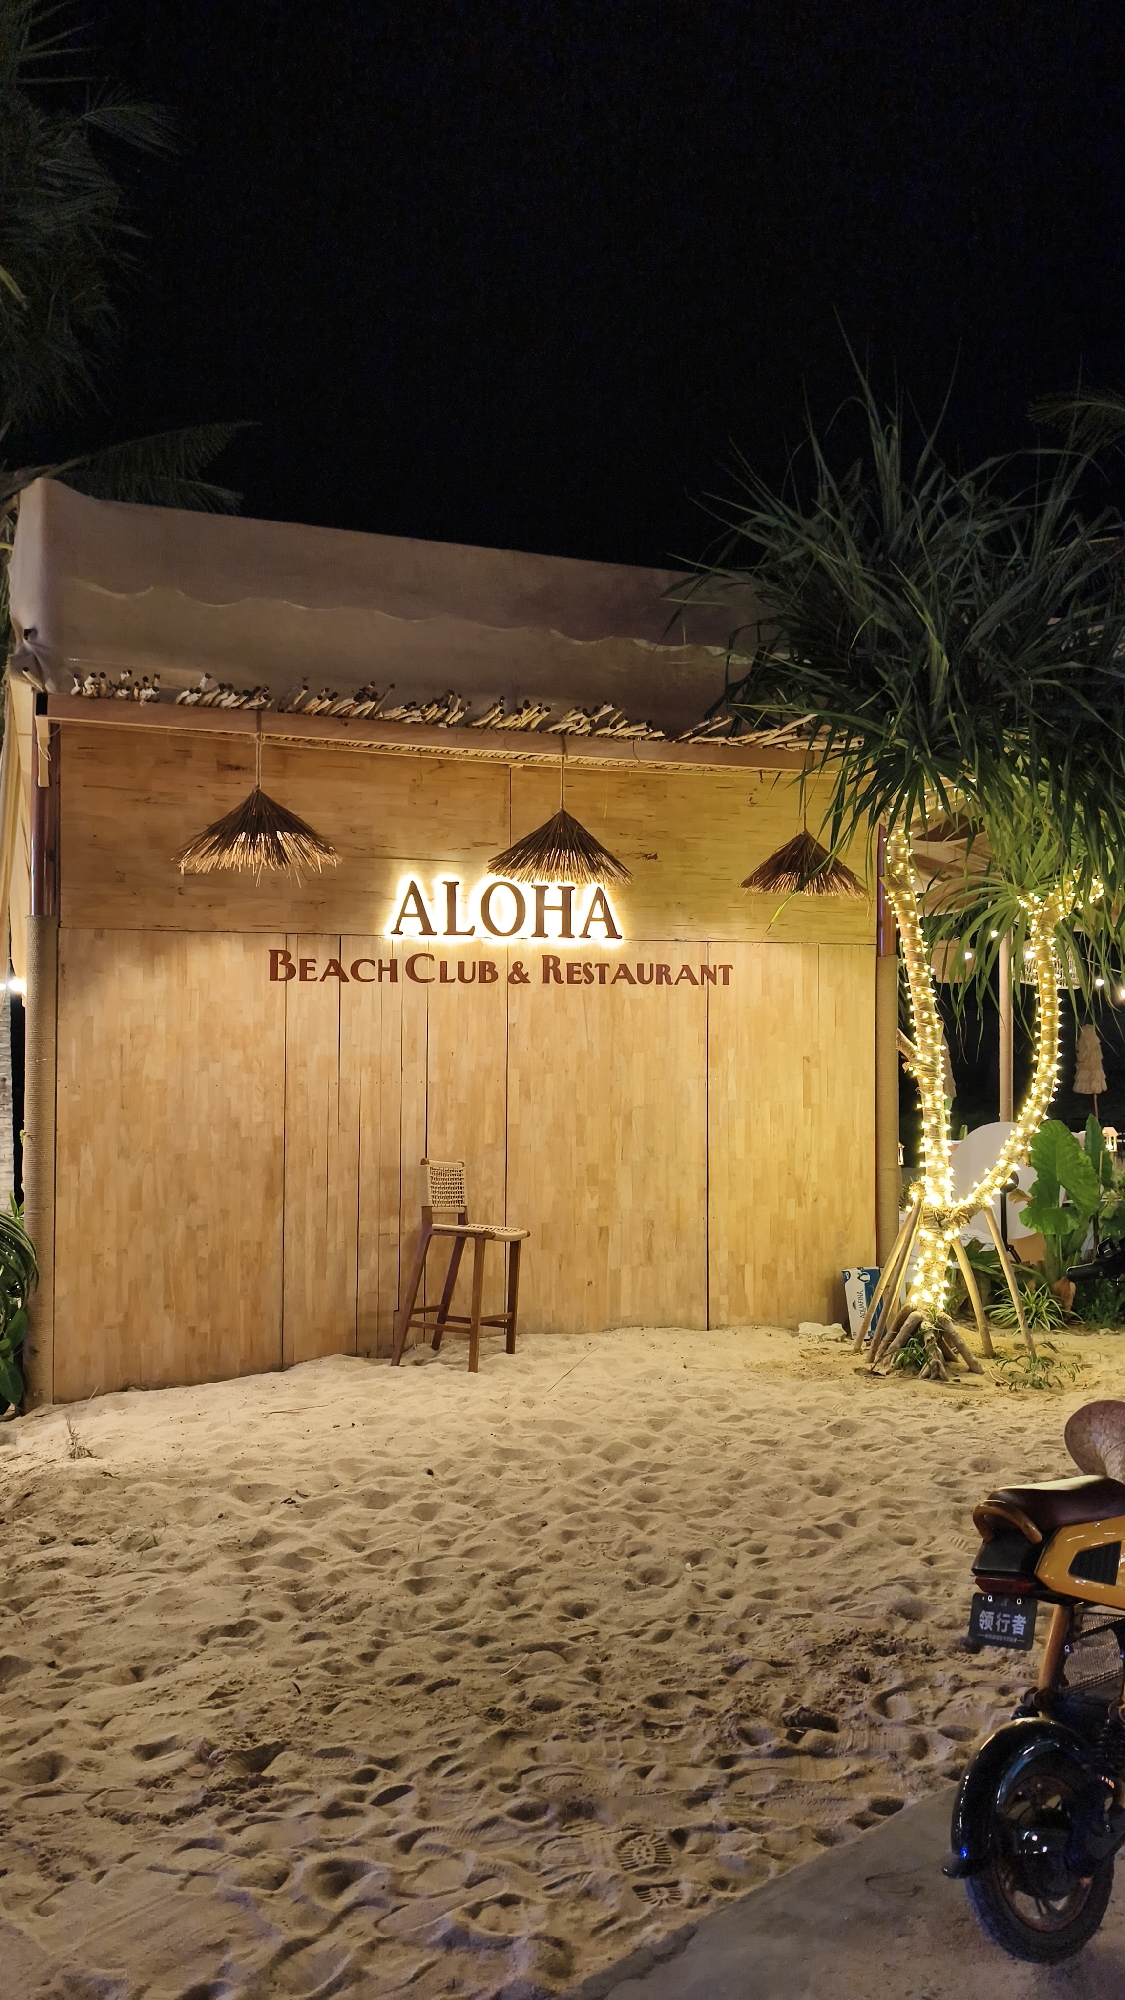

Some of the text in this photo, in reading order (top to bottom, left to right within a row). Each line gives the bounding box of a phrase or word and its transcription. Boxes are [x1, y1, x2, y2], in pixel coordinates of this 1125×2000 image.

[390, 880, 623, 939] ALOHA
[269, 949, 734, 986] BEACH CLUB & RESTAURANT
[856, 1289, 867, 1319] AQUAFINA
[979, 1610, 1027, 1636] 领行者
